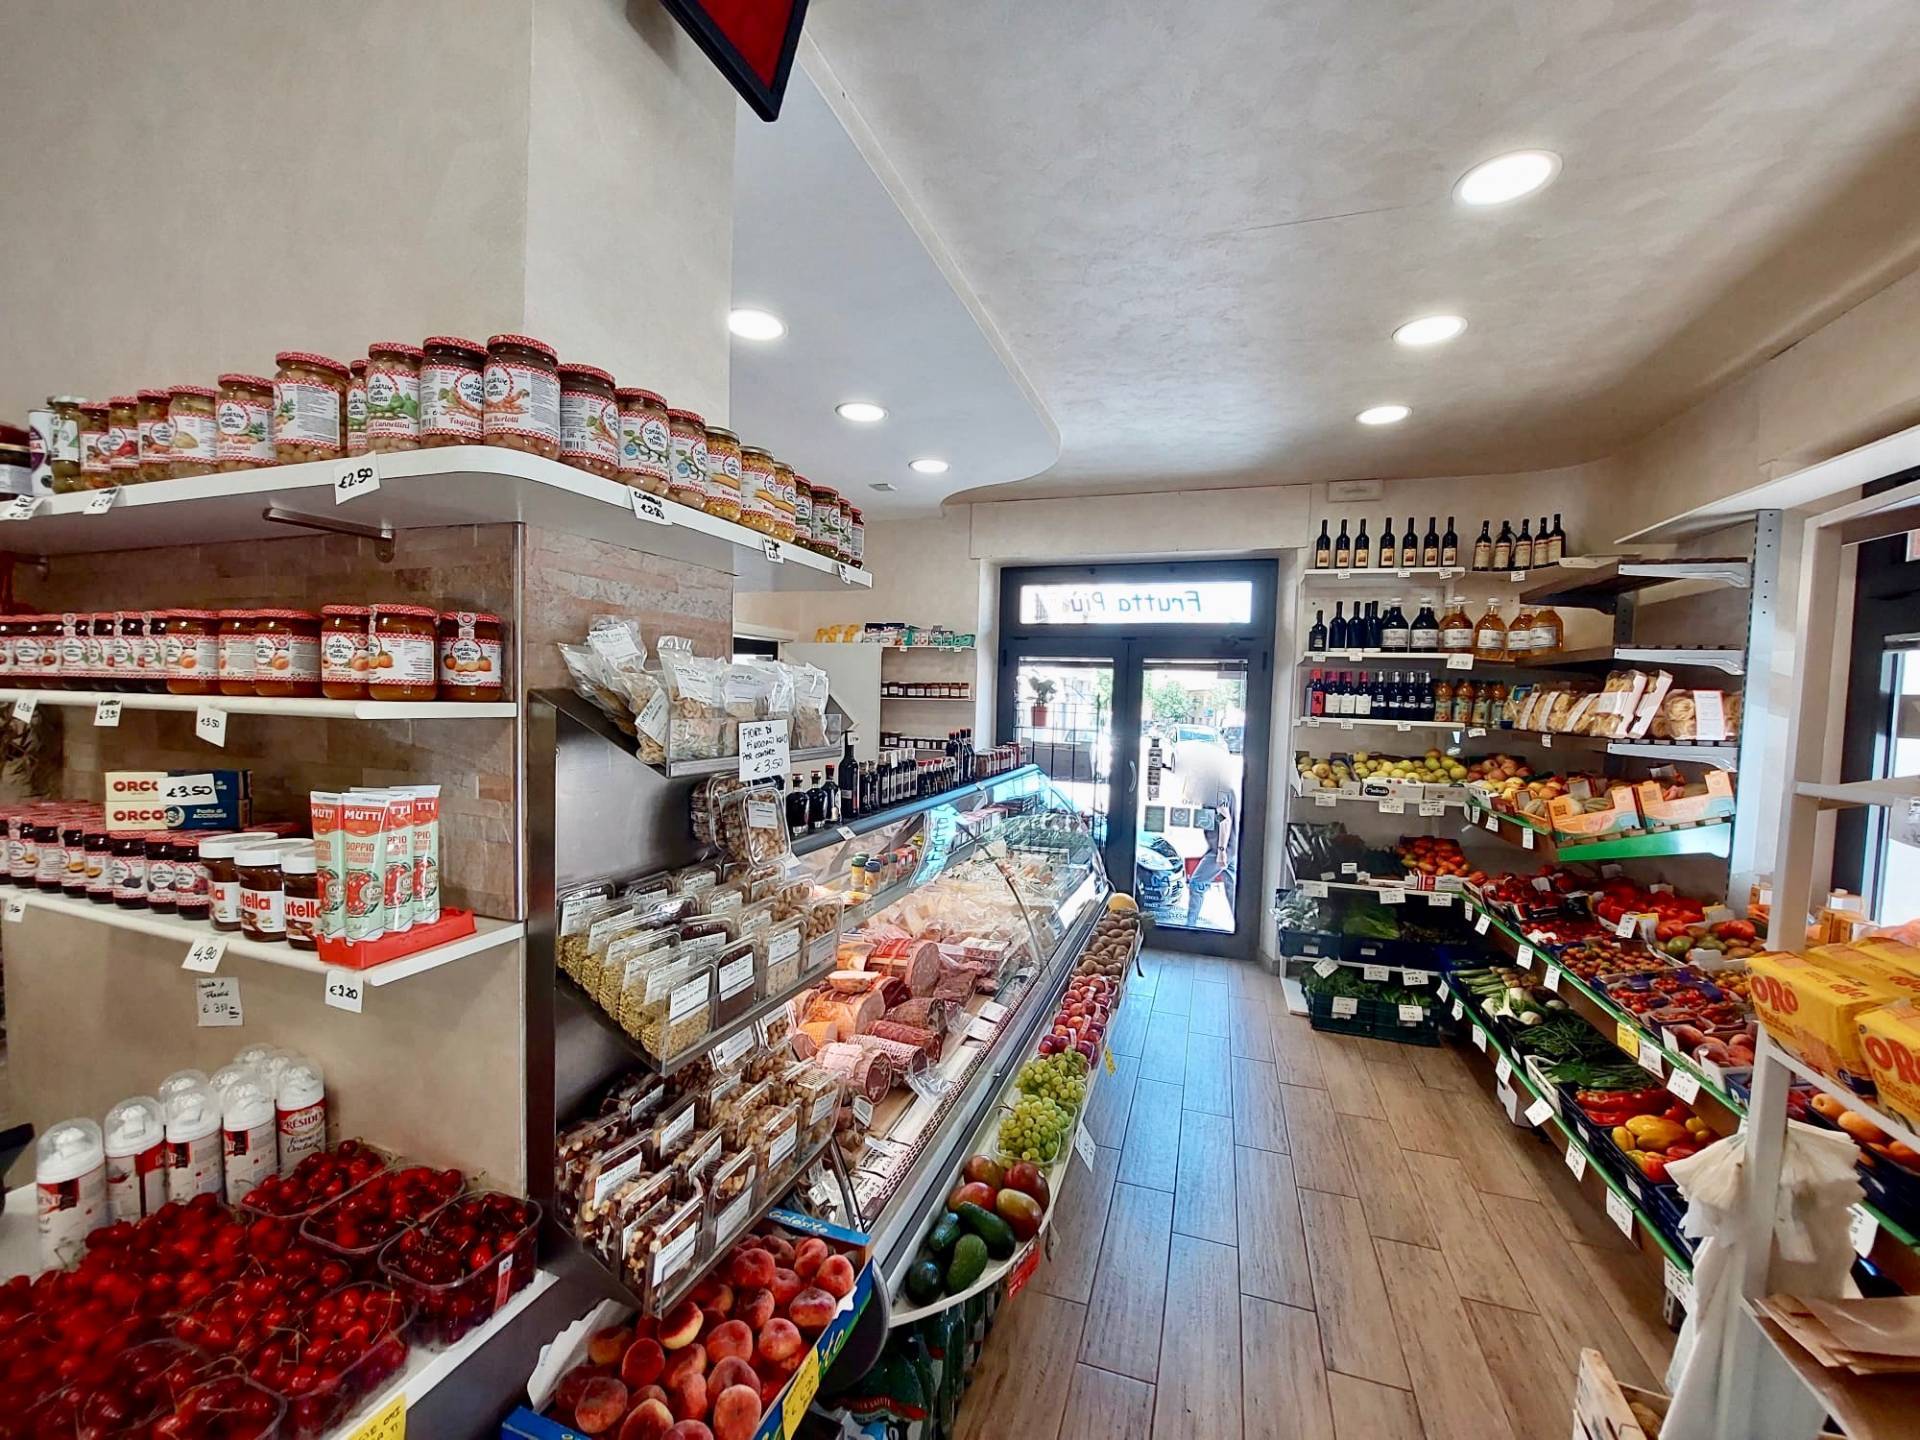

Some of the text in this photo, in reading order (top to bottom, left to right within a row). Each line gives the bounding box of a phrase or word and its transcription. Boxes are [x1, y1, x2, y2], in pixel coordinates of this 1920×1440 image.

[494, 415, 519, 424] Borlotti
[375, 421, 410, 430] Cannellini
[390, 805, 411, 815] TTI
[416, 802, 435, 811] TTI
[113, 809, 165, 822] ORCO
[344, 809, 382, 821] MUTTI
[346, 842, 375, 851] DOPPIO
[1750, 975, 1799, 1015] ORO
